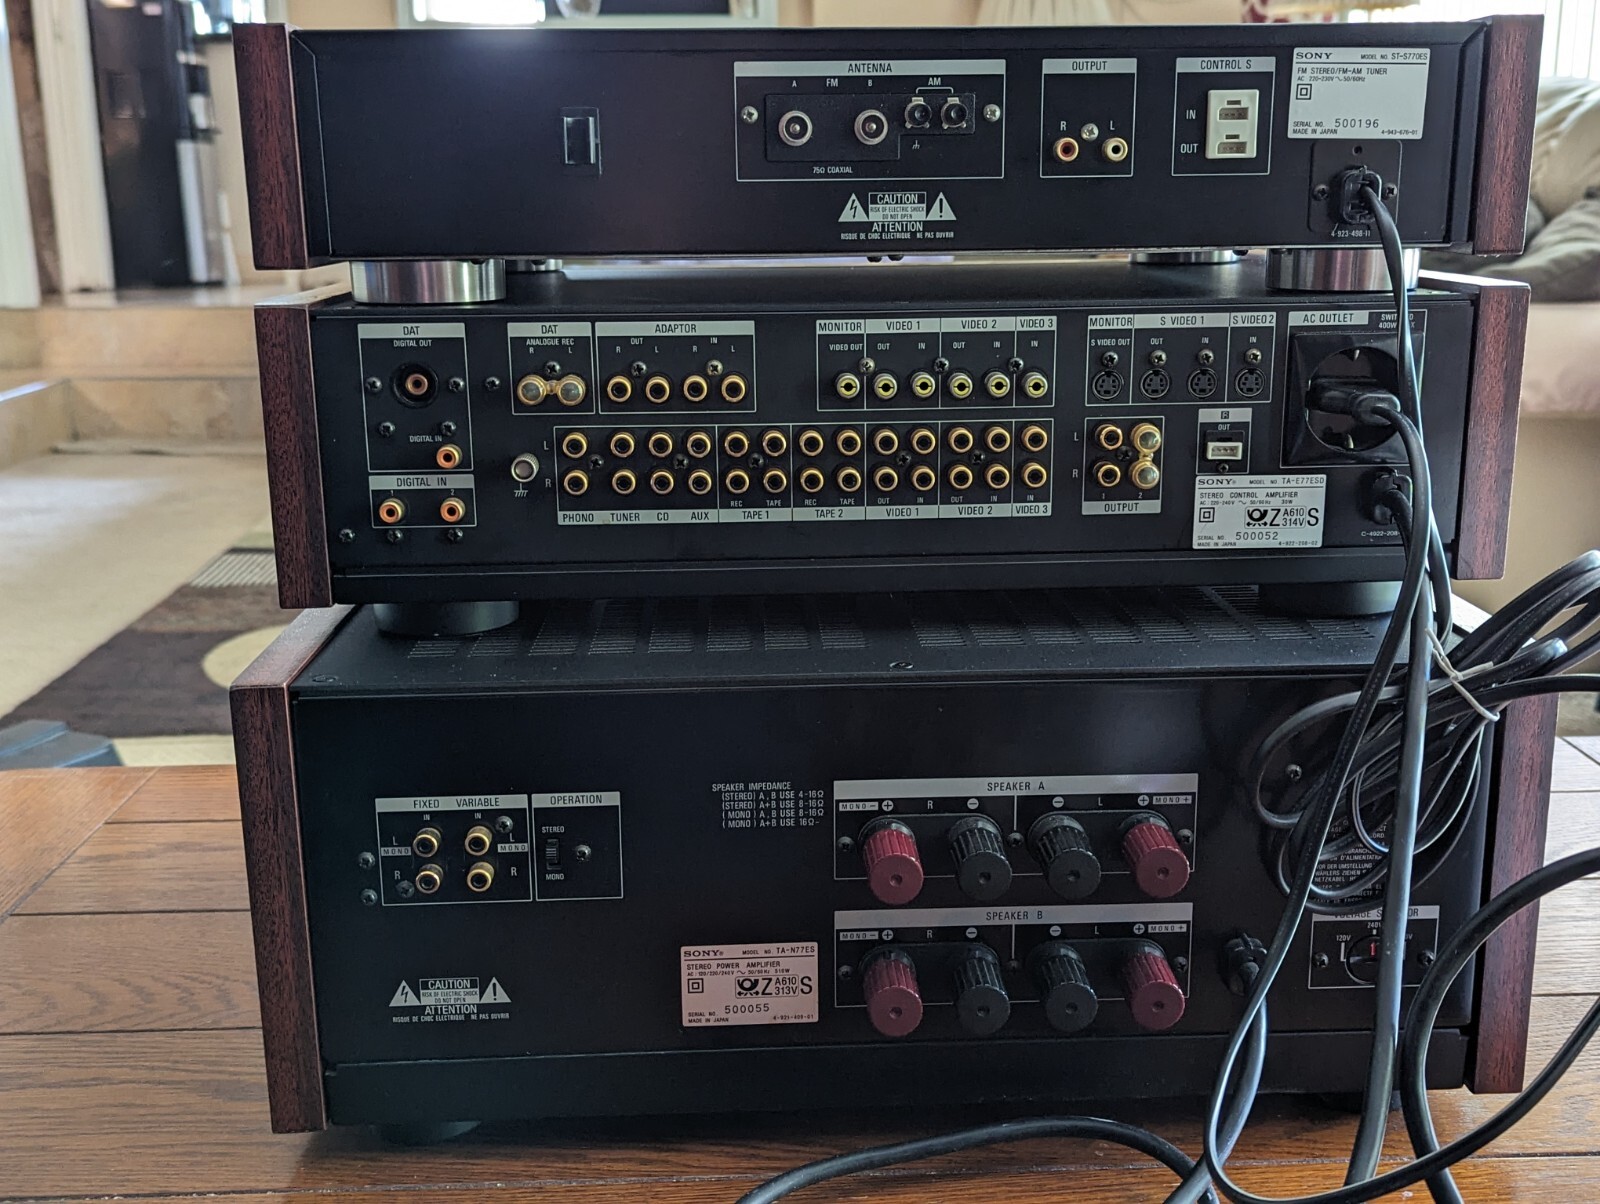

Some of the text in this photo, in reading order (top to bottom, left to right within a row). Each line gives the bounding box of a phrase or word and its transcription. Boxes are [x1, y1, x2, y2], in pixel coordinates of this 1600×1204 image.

[1295, 52, 1333, 60] SONY
[1391, 52, 1428, 60] ST-S770ES
[847, 63, 893, 74] ANTENNA
[1072, 61, 1107, 71] OUTPUT
[1200, 59, 1252, 70] CONTROL S
[1310, 67, 1362, 75] STEREO/FM-AM
[826, 78, 838, 87] FM
[928, 77, 941, 86] AM
[1186, 110, 1196, 120] IN
[1060, 121, 1067, 131] R
[1110, 120, 1115, 130] L
[1335, 118, 1379, 128] 500196
[1180, 143, 1198, 154] OUT
[827, 166, 853, 174] COAXIAL
[877, 194, 918, 204] CAUTION
[872, 221, 923, 232] ATTENTION
[841, 232, 857, 240] RISQUE
[860, 232, 866, 240] DE
[868, 232, 880, 240] CHOC
[1019, 318, 1053, 328] VIDEO 3
[1089, 317, 1133, 327] MONITOR
[1160, 316, 1166, 326] S
[1170, 315, 1197, 325] VIDEO
[1232, 314, 1274, 324] S VIDEO 2
[1303, 313, 1354, 323] AC OUTLET
[541, 324, 558, 334] DAT
[654, 324, 697, 333] ADAPTOR
[818, 322, 862, 332] MONITOR
[886, 321, 912, 331] VIDEO
[961, 319, 997, 329] VIDEO 2
[403, 326, 420, 336] DAT
[393, 339, 432, 347] DIGITAL OUT
[526, 338, 575, 346] ANALOGUE REC
[630, 337, 643, 345] OUT
[918, 342, 926, 350] IN
[952, 341, 966, 349] OUT
[1118, 338, 1130, 346] OUT
[850, 343, 863, 351] OUT
[409, 435, 433, 443] DIGITAL
[396, 477, 447, 487] DIGITAL IN
[877, 497, 890, 505] OUT
[886, 508, 912, 517] VIDEO
[958, 506, 993, 516] VIDEO 2
[1015, 505, 1048, 515] VIDEO 3
[1104, 503, 1139, 512] OUTPUT
[562, 513, 594, 523] PHONO
[610, 512, 640, 522] TUNER
[656, 512, 669, 521] CD
[691, 511, 710, 521] AUX
[742, 510, 763, 520] TAPE
[815, 509, 843, 519] TAPE 2
[1270, 507, 1319, 527] Z A610 S
[1282, 517, 1305, 527] 314V
[1235, 531, 1279, 541] 500052
[712, 781, 791, 792] SPEAKER IMPEDANCE
[987, 781, 1045, 792] SPEAKER A
[413, 799, 440, 809] FIXED
[456, 797, 500, 808] VARIABLE
[550, 795, 603, 806] OPERATION
[722, 801, 756, 810] (STEREO)
[759, 801, 776, 809] A+B
[780, 800, 795, 808] USE
[986, 910, 1043, 921] SPEAKER B
[776, 946, 815, 954] TA-N77ES
[428, 979, 471, 990] CAUTION
[761, 976, 813, 996] Z A610 S
[774, 986, 798, 995] 313V
[424, 1004, 477, 1015] ATTENTION
[725, 1003, 770, 1014] 500055
